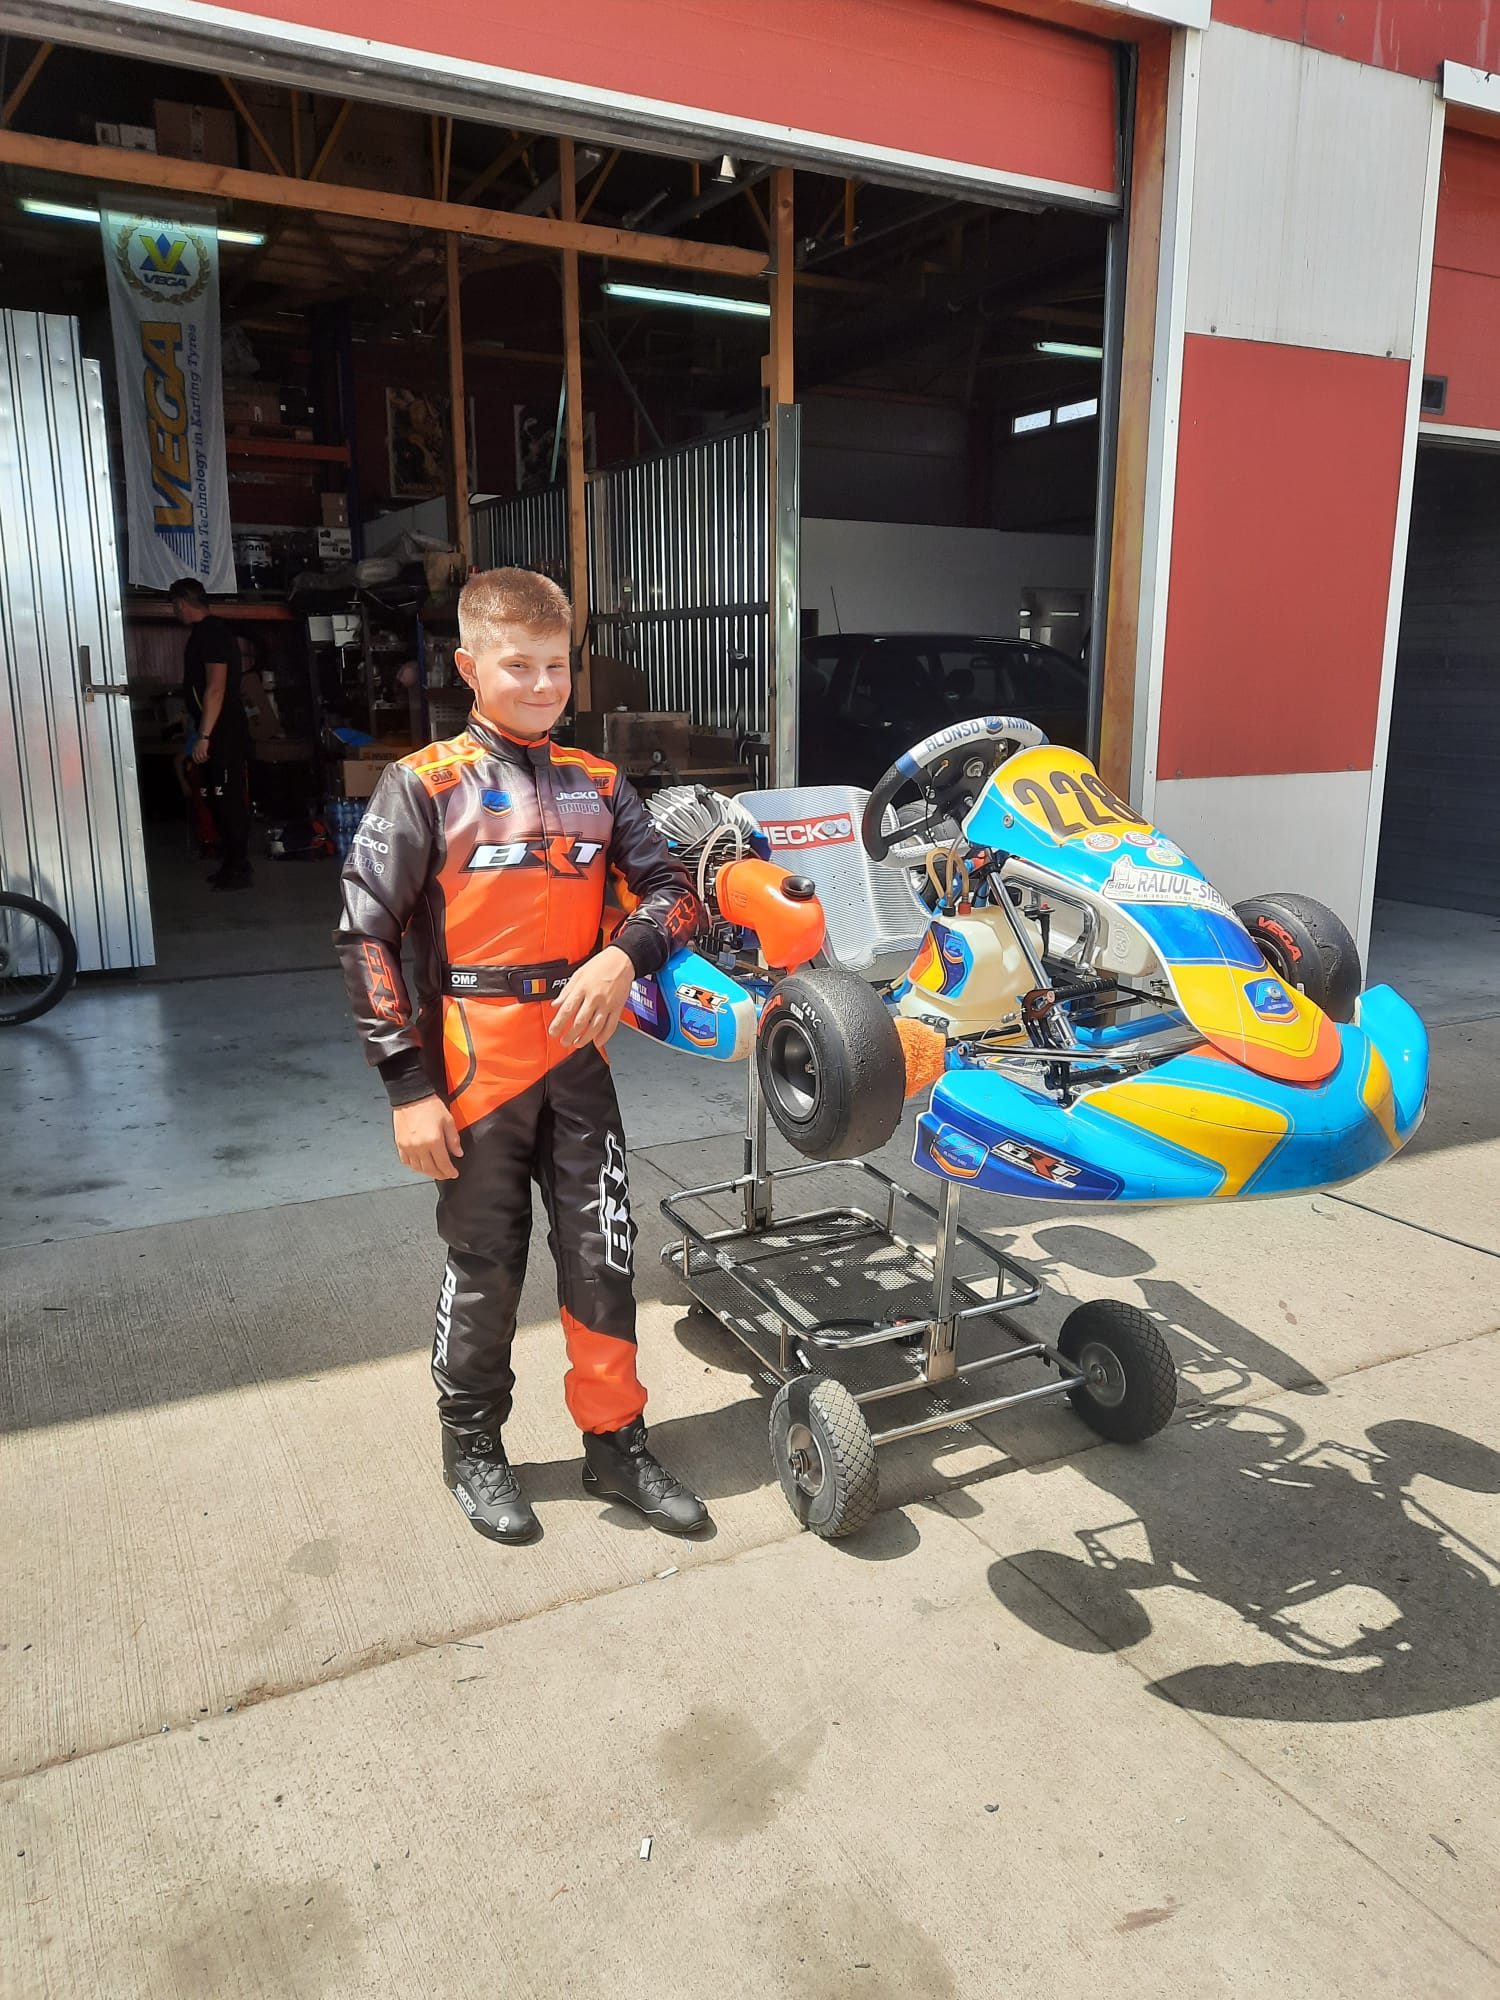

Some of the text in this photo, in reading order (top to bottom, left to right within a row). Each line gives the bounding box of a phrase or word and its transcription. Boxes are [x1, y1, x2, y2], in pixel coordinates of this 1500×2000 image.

[143, 274, 187, 288] VEGA
[141, 321, 194, 533] VEGA
[187, 324, 211, 575] High Technology in Karting Tyres
[924, 720, 980, 752] ALONSO
[430, 770, 454, 783] OMP
[555, 790, 599, 801] JECKO
[1012, 770, 1149, 838] 228
[466, 834, 604, 876] BRT
[1258, 916, 1302, 961] VEGA
[451, 974, 478, 986] OMP
[677, 984, 728, 1010] BRT
[996, 1140, 1078, 1180] BRT
